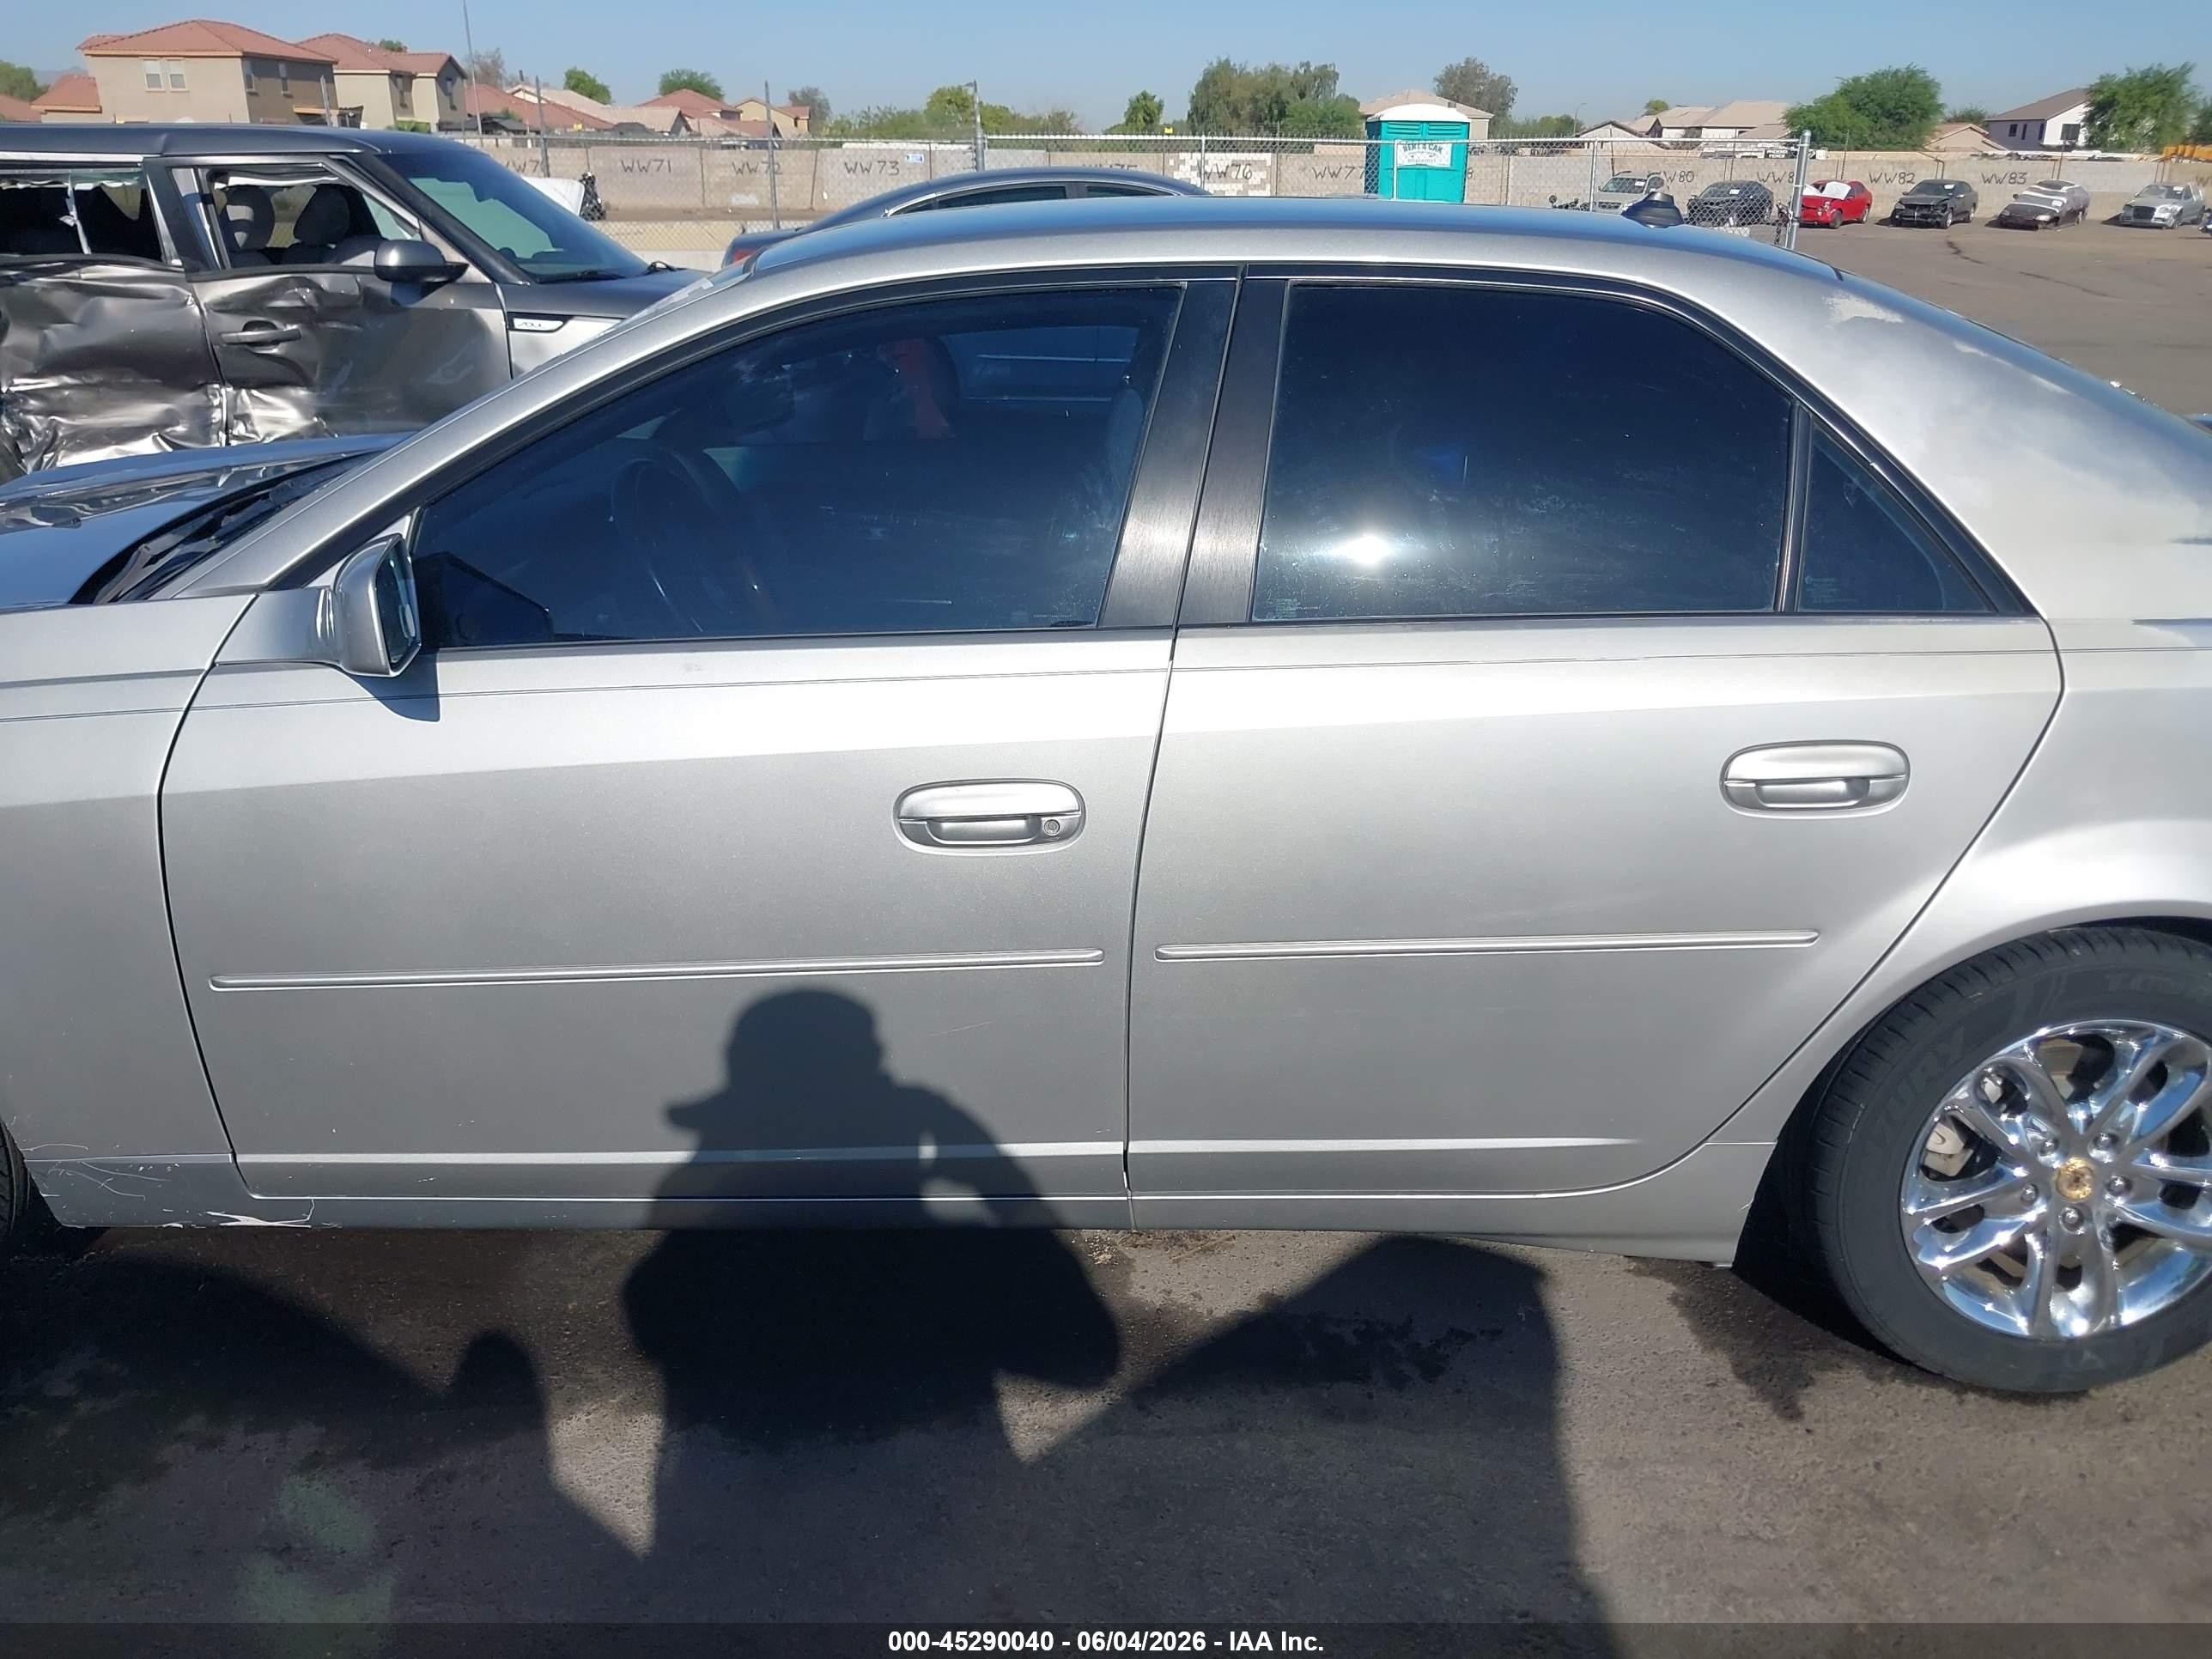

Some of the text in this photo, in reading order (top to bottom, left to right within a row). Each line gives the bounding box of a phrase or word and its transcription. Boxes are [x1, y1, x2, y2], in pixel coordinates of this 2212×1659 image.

[621, 159, 672, 173] WW71
[1869, 172, 1915, 185] WW82
[1981, 172, 2027, 185] WW83
